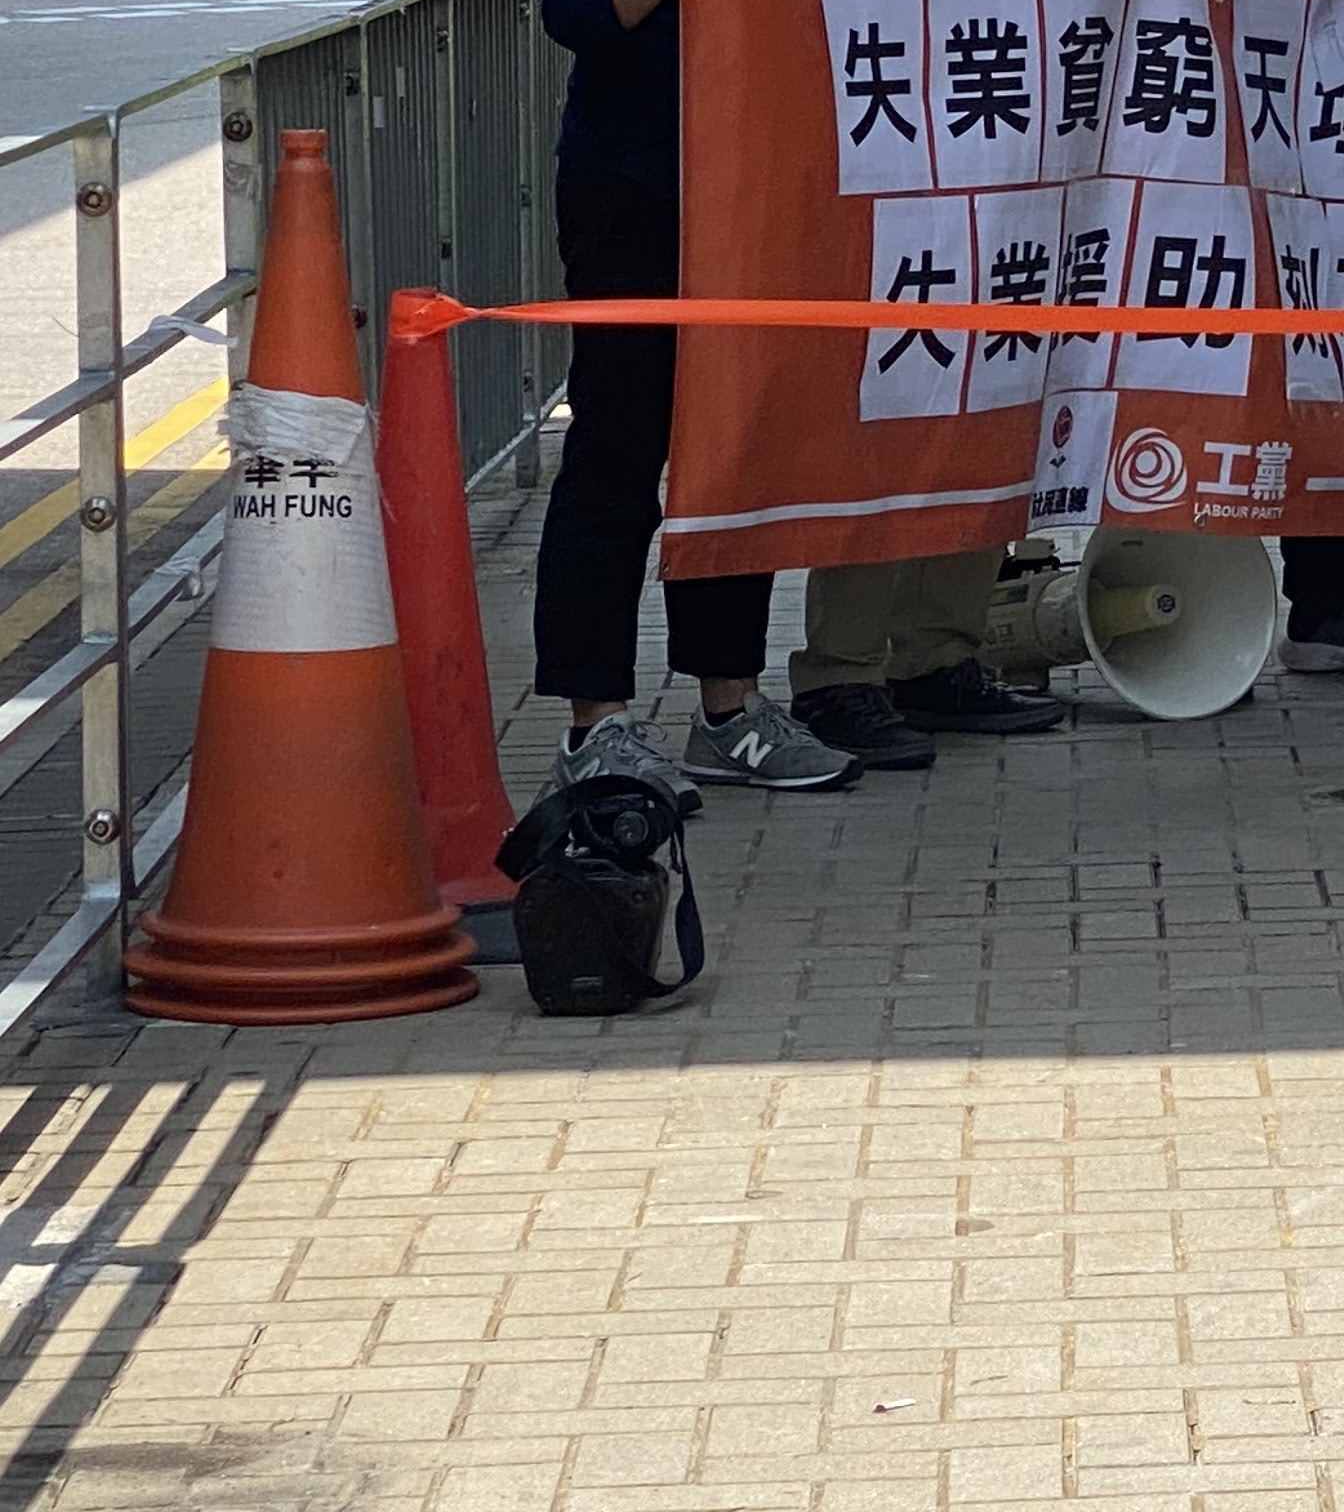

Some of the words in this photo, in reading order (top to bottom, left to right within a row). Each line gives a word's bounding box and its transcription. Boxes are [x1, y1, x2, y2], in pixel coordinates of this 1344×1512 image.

[1196, 440, 1293, 501] 工黨
[233, 494, 276, 519] WAH
[284, 494, 352, 519] FUNG
[1194, 501, 1249, 519] LABOUR
[1251, 505, 1284, 520] PARTY
